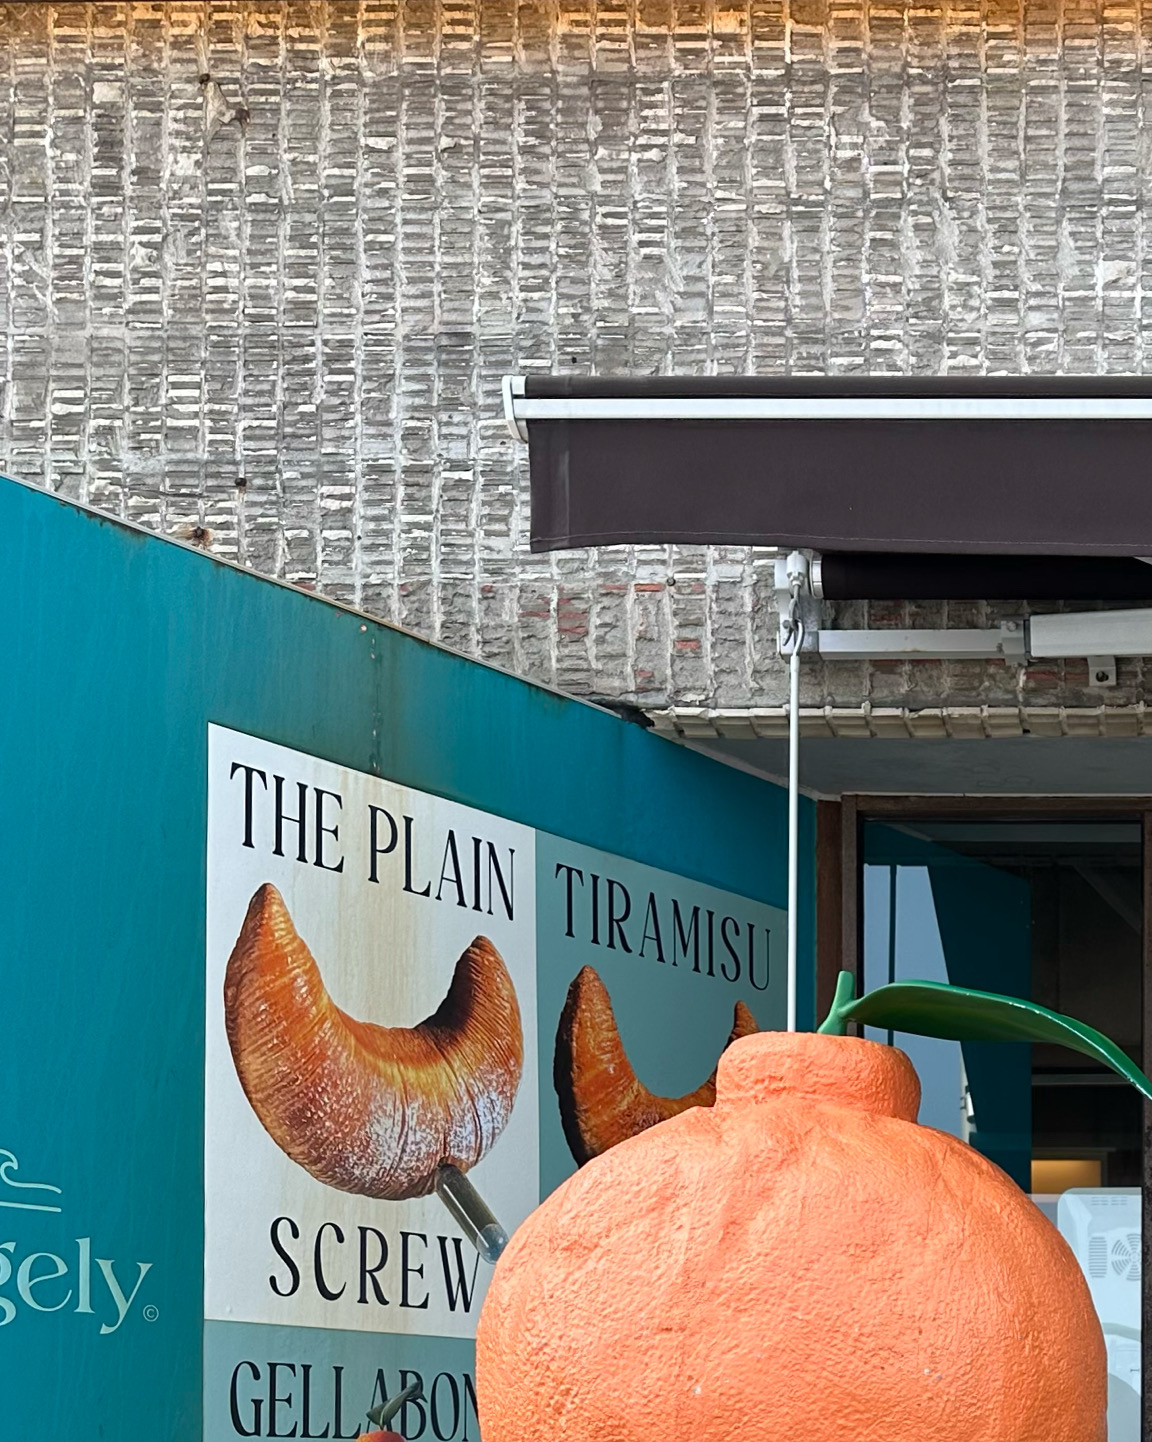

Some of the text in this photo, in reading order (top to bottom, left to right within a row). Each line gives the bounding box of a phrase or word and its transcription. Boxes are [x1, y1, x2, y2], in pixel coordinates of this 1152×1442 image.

[230, 761, 516, 922] THE PLAIN
[554, 862, 772, 991] TIRAMISU
[268, 1215, 481, 1314] SCREW
